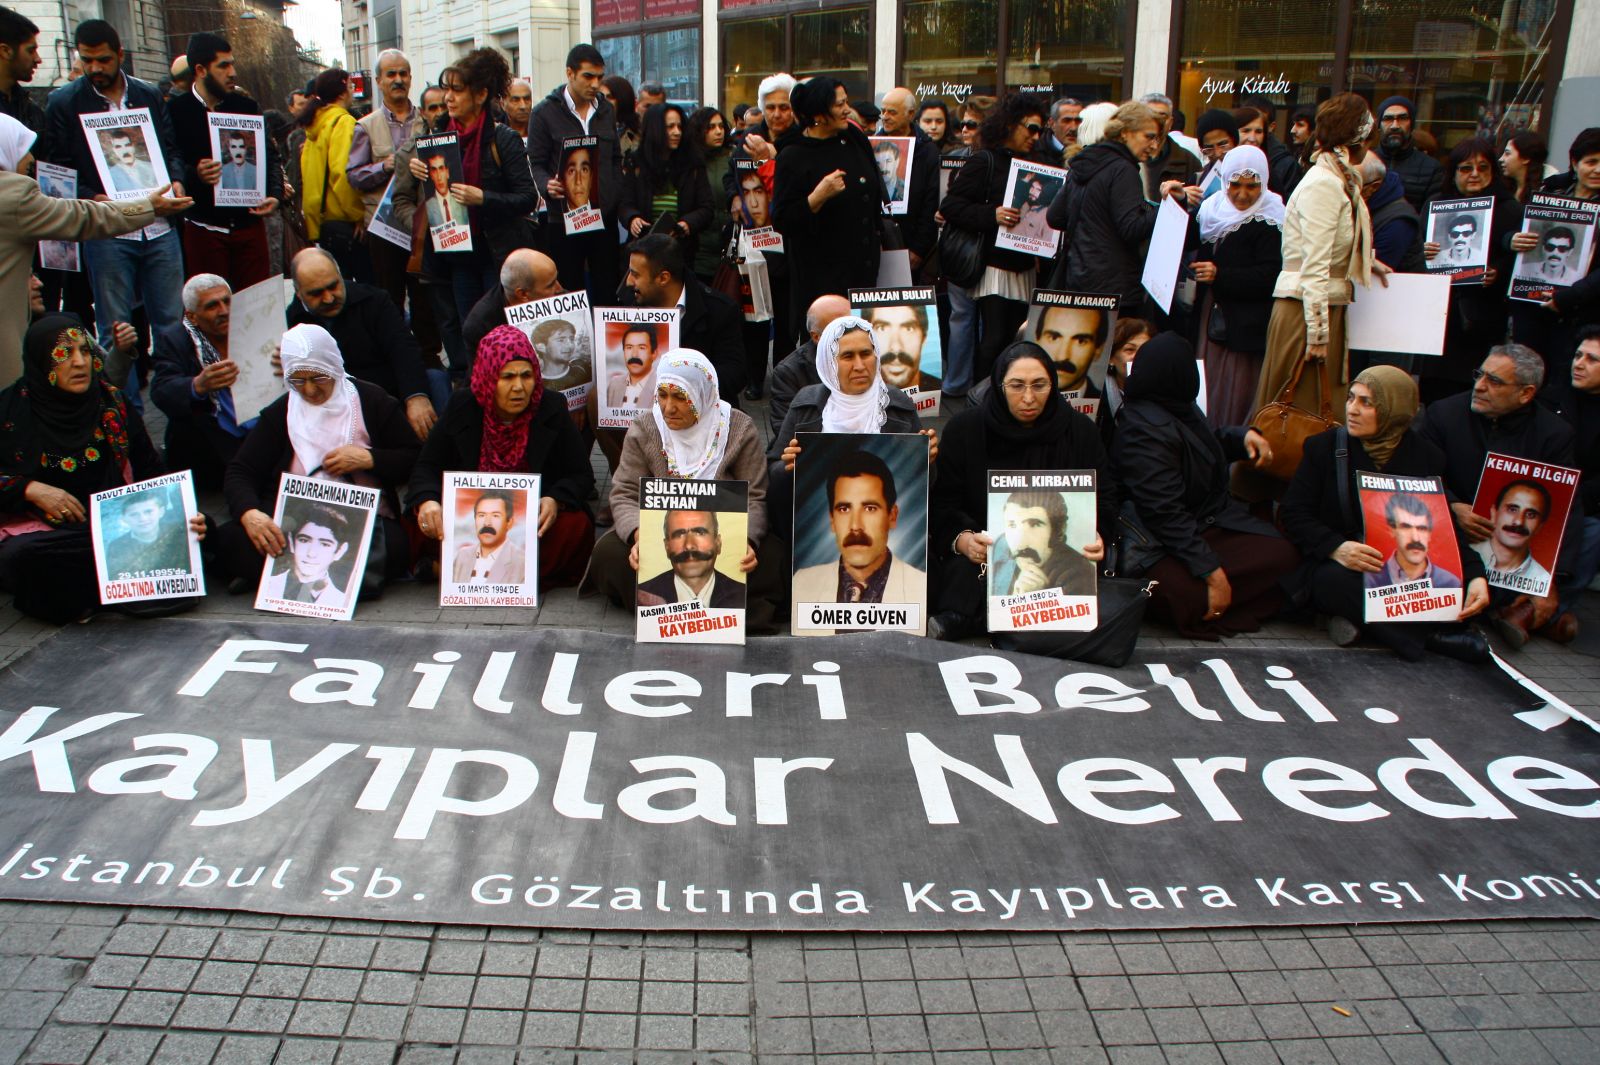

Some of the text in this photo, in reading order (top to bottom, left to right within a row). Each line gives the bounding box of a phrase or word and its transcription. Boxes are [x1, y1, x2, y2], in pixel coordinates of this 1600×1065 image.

[915, 81, 973, 104] Ayın Yazarı
[1199, 76, 1236, 104] Ayın
[1240, 72, 1291, 94] Kitabı
[118, 113, 149, 126] YURTSEVEN
[1472, 200, 1491, 208] EREN
[1571, 212, 1593, 221] EREN
[852, 289, 932, 303] RAMAZAN BULUT
[1036, 292, 1116, 309] RIDVAN KARAKOÇ
[509, 293, 588, 324] HASAN OCAK
[602, 310, 676, 323] HALİL ALPSOY
[600, 417, 632, 427] GÖZALTIN
[1486, 458, 1577, 486] KENAN BİLGİN
[96, 473, 187, 502] DAVUT ALTUNKAYNAK
[453, 475, 536, 489] HALİL ALPSOY
[645, 479, 716, 496] SÜLEYMAN
[1032, 475, 1092, 488] KIRBAYIR
[1396, 479, 1438, 492] TOSUN
[284, 478, 348, 504] ABDURRAHMAN
[644, 496, 698, 510] SEYHAN
[105, 582, 155, 600] GÖZALTINDA
[458, 585, 520, 594] 10 MAYIS 1994'DE
[1368, 590, 1376, 598] 19
[442, 594, 489, 605] GÖZALTINDA
[1001, 598, 1006, 607] 8
[640, 606, 666, 618] KASIM
[658, 610, 707, 624] GÖZALTINDA
[811, 605, 907, 626] ÖMER GÜVEN
[177, 639, 848, 720] Failleri
[0, 706, 1600, 842] Kayıplar Nerede
[321, 865, 426, 903] Şb.
[470, 873, 869, 914] Gözaltında
[902, 878, 1242, 919] Kayıplara
[1255, 877, 1425, 911] Karşı
[1438, 871, 1600, 902] Komi
